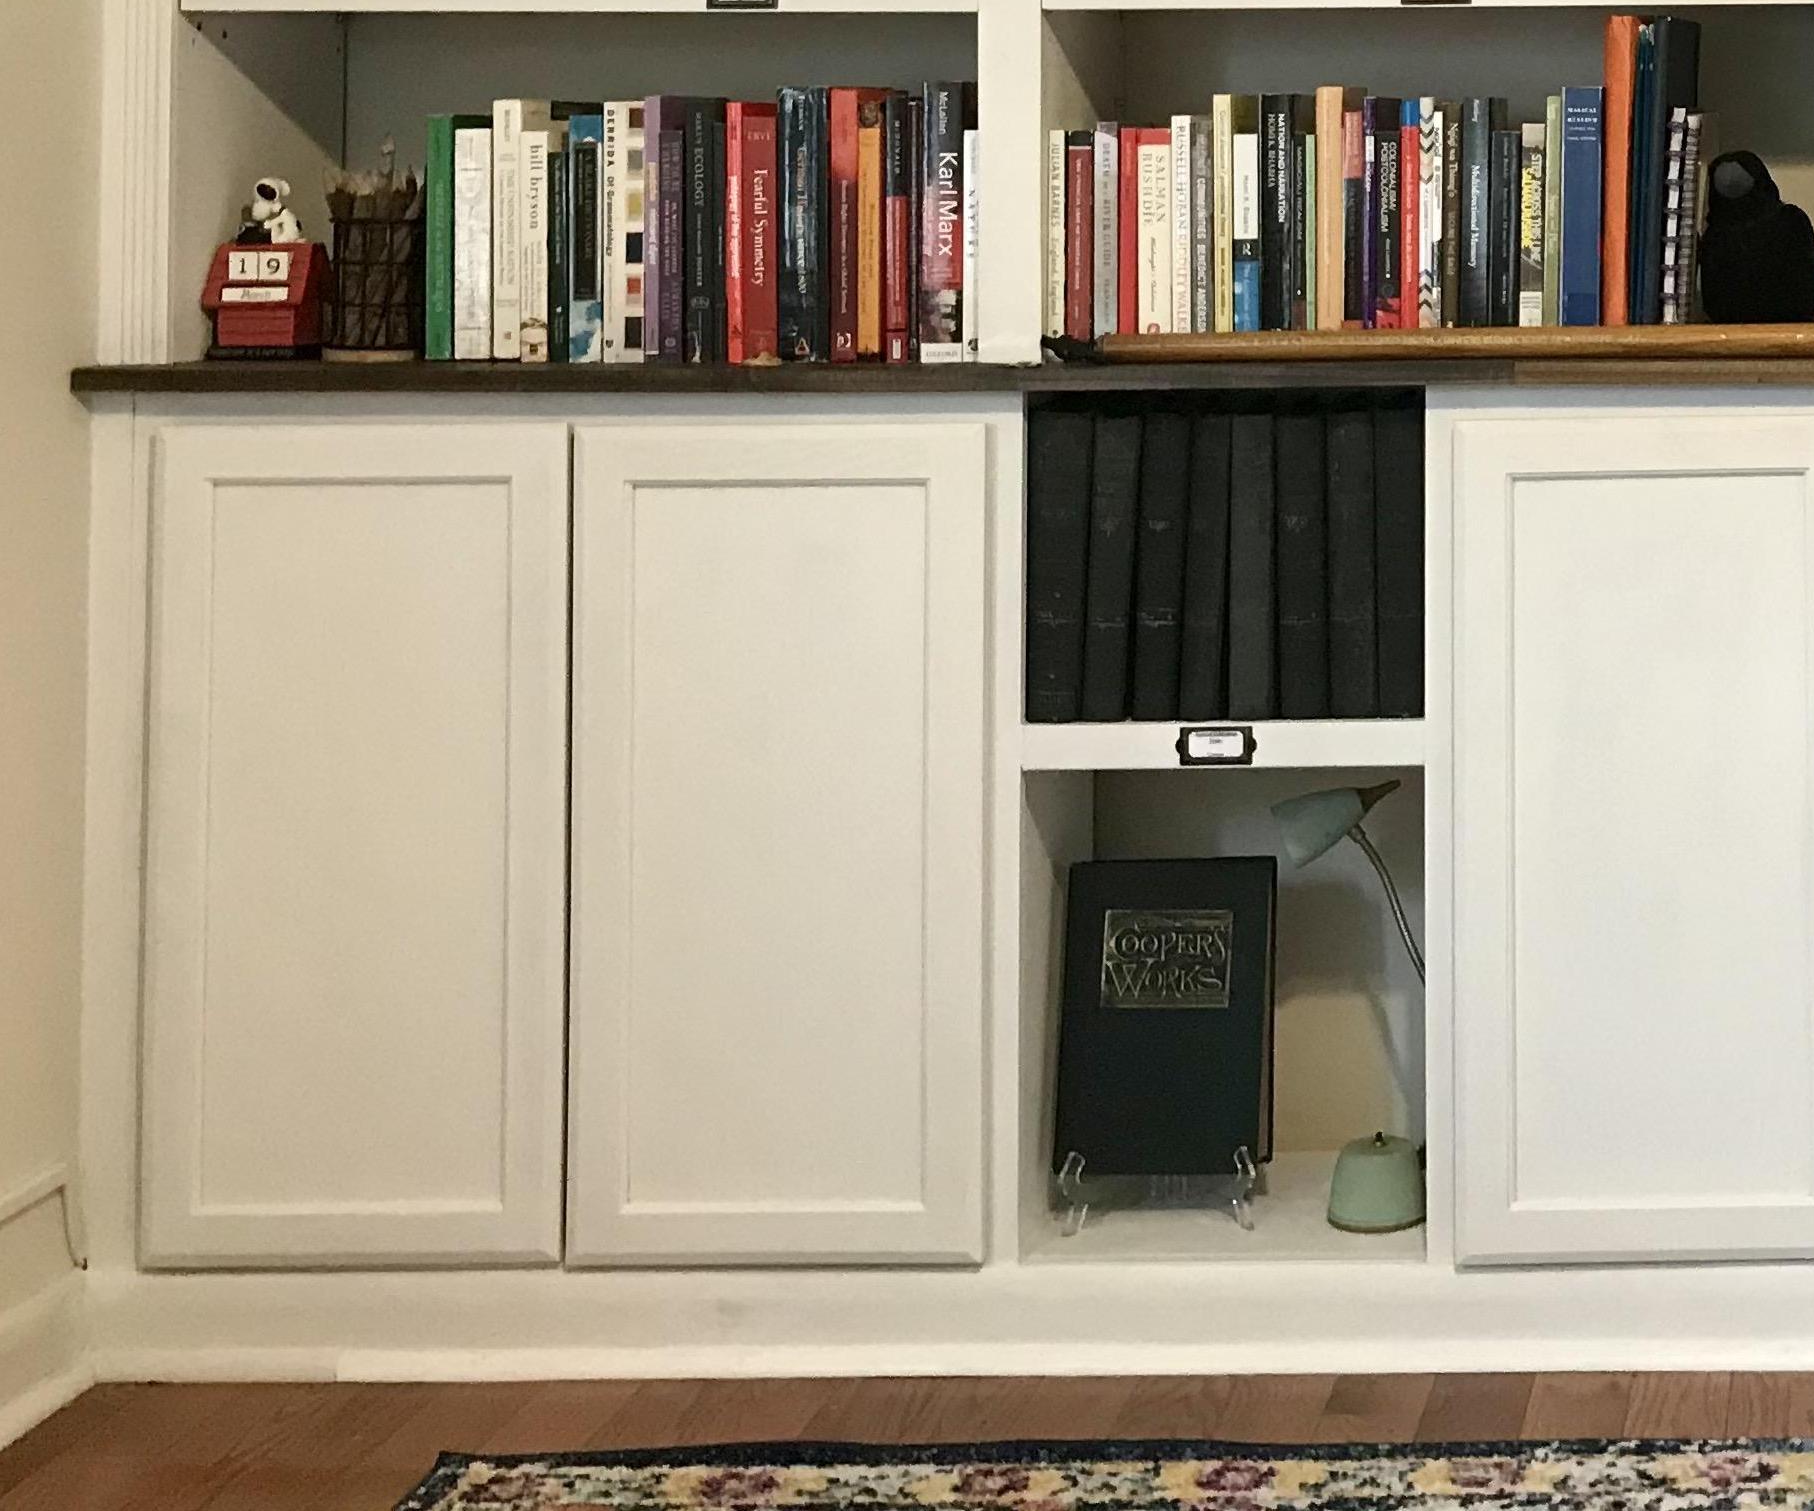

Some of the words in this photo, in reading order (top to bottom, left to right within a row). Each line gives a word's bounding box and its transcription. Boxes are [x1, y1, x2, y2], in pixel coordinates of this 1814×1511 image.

[530, 145, 543, 170] bill
[938, 152, 958, 195] Karl
[527, 176, 540, 229] bryson
[754, 169, 769, 214] Fearful
[1142, 153, 1154, 226] RUSHDIE
[1155, 155, 1166, 224] SALMAN
[751, 219, 768, 287] Symmetry
[938, 200, 958, 256] Marx
[1103, 958, 1222, 998] WORKS
